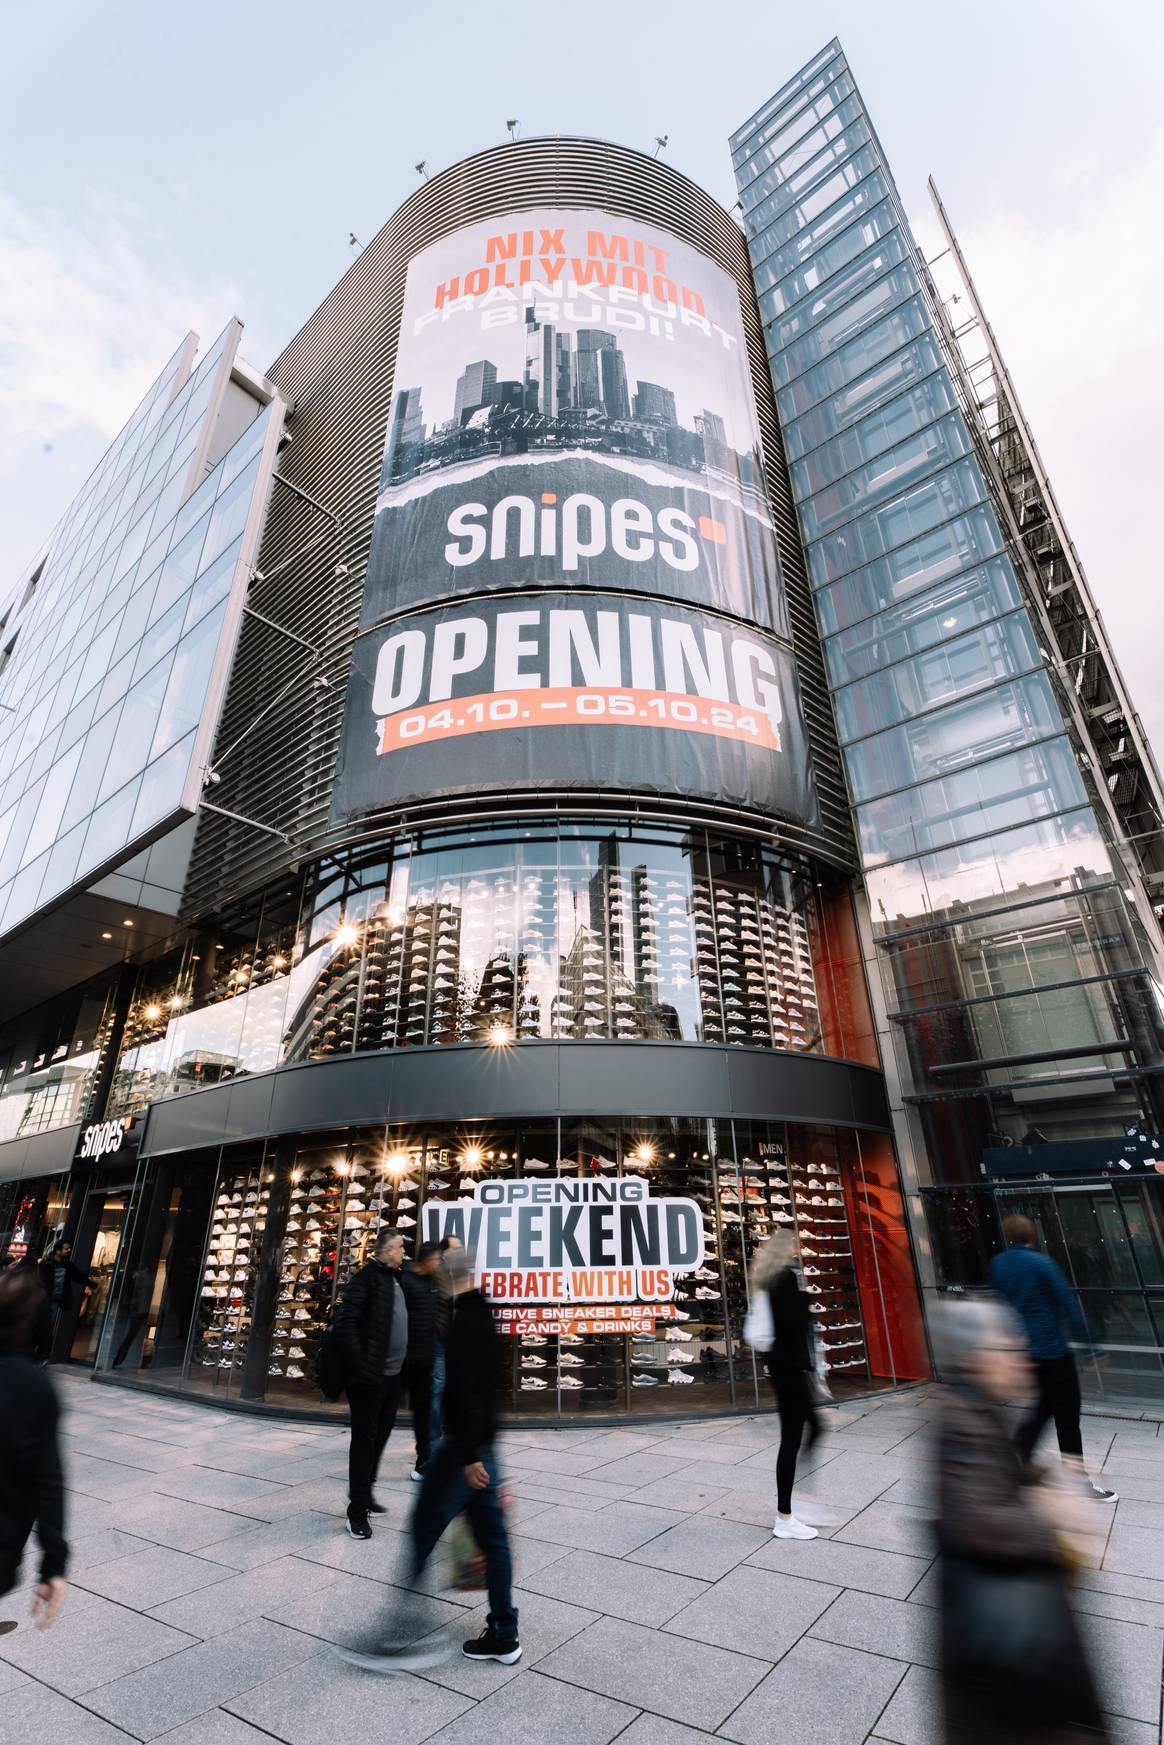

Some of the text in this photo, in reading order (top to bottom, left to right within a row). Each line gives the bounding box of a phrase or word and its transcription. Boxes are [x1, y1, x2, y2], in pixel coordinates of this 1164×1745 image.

[486, 229, 671, 274] NIX MIT
[434, 258, 705, 317] HOLLYWOOD
[413, 280, 738, 350] FRANKFURT
[481, 301, 675, 340] BRUDI!
[445, 493, 700, 571] snipes
[371, 610, 782, 722] OPENING
[399, 698, 531, 738] 04.10.
[576, 695, 759, 737] 05.10.24
[81, 1118, 125, 1162] snipes
[763, 1143, 783, 1154] MEN
[480, 1181, 643, 1204] OPENING
[428, 1204, 699, 1269] WEEKEND
[481, 1270, 670, 1298] EBRATE WITH US
[492, 1306, 671, 1319] USIVE SNEAKER DEALS
[496, 1321, 651, 1334] EE CANDY & DRINKS
